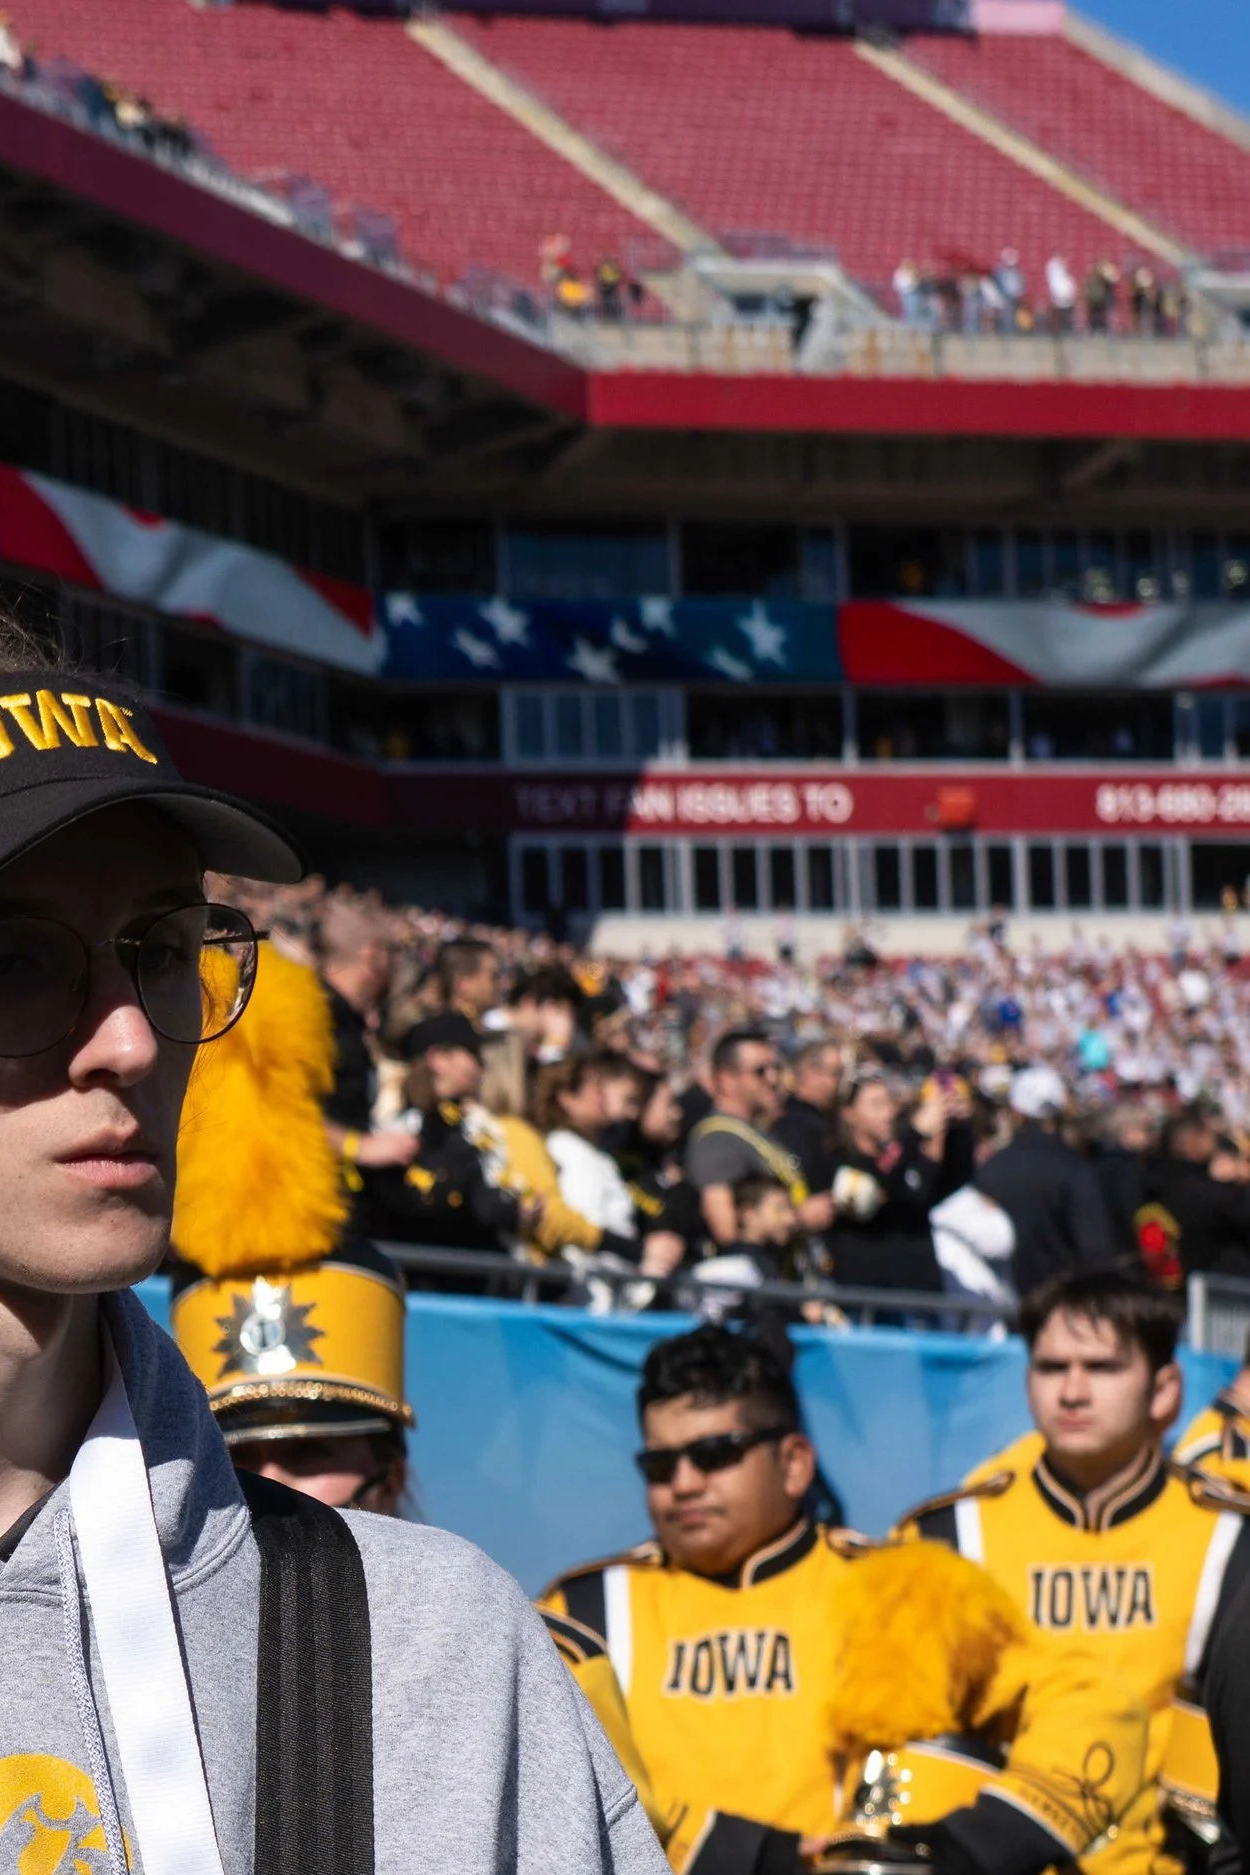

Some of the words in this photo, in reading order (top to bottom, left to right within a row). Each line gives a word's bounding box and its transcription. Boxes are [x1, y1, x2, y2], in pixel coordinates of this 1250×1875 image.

[676, 781, 800, 824] ISSUES
[801, 781, 855, 824] TO
[1028, 1564, 1155, 1630] IOWA
[664, 1628, 796, 1698] IOWA
